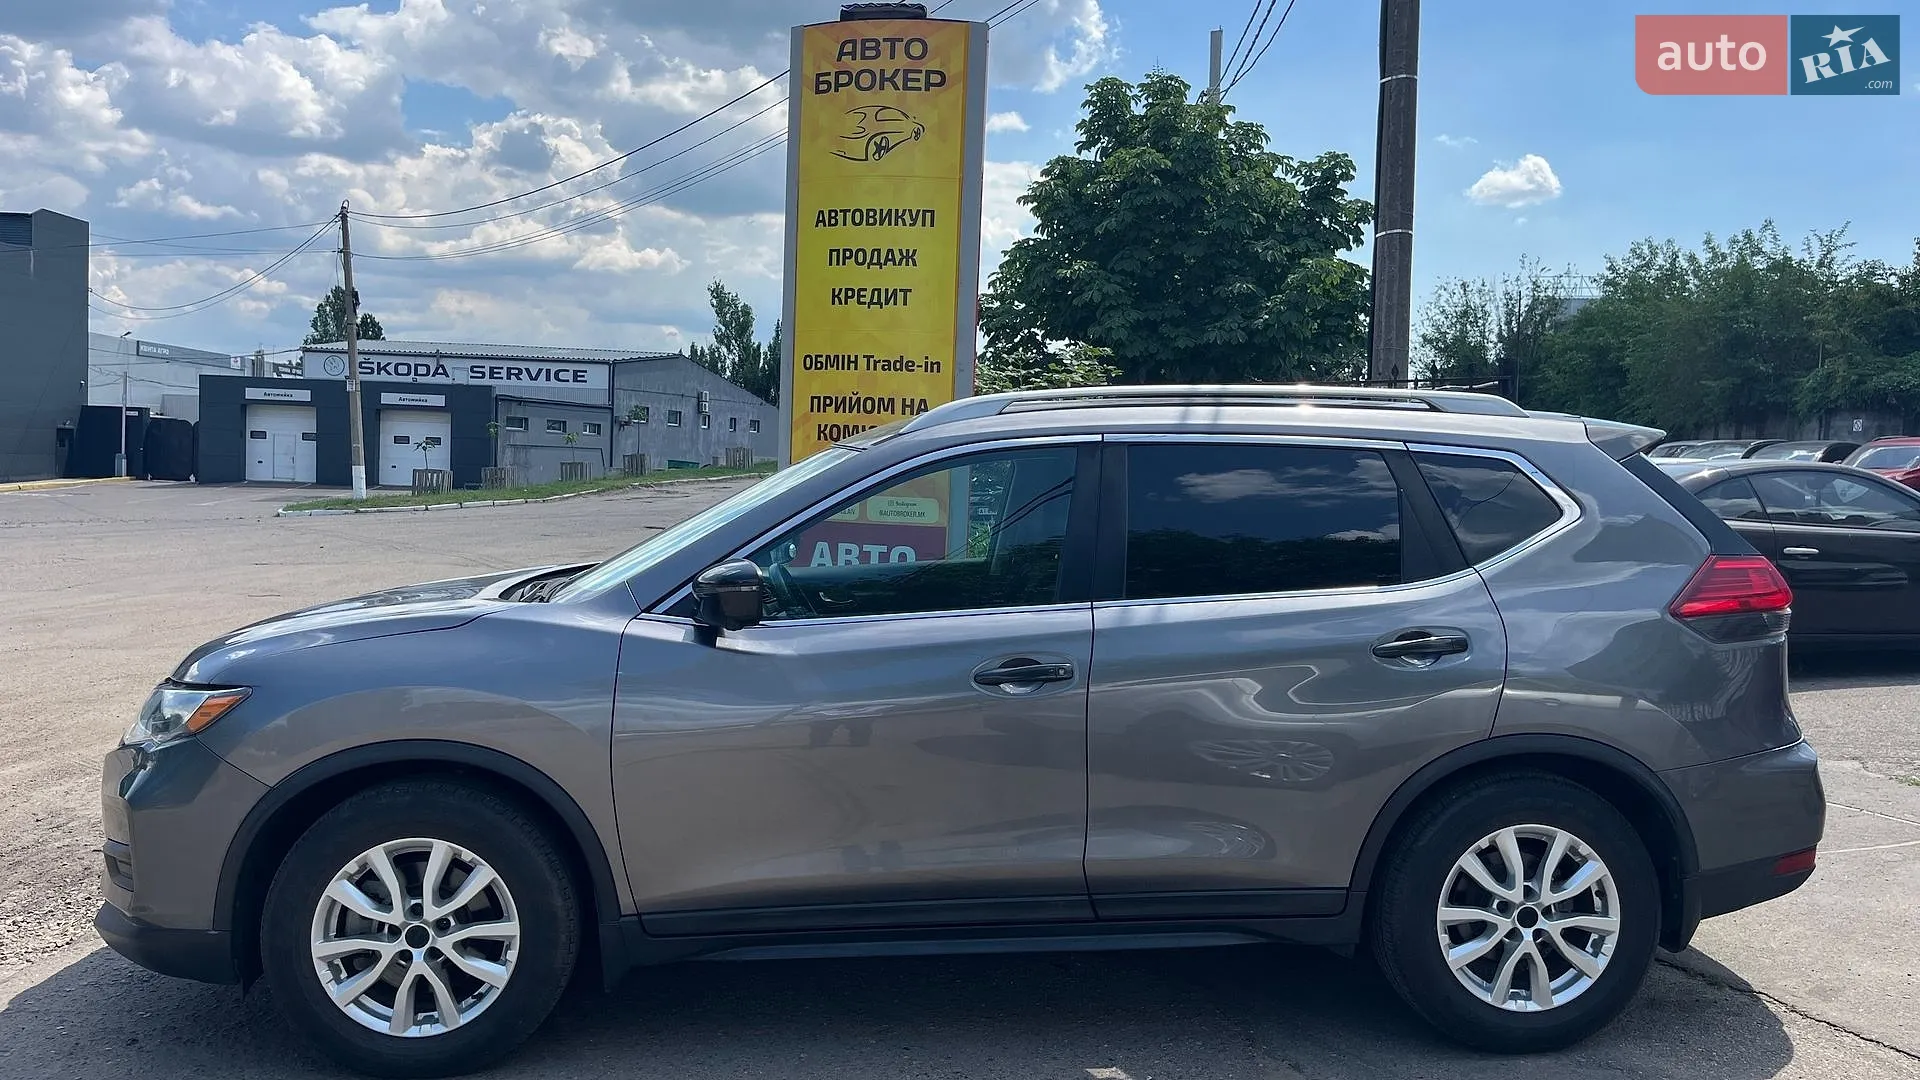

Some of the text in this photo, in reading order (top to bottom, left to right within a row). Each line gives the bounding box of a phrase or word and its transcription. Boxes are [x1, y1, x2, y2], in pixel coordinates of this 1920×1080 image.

[837, 37, 928, 62] АВТО
[814, 68, 947, 95] БРОКЕР
[814, 208, 936, 228] АВТОВИКУП
[828, 248, 918, 270] ПРОДАЖ
[831, 287, 913, 309] КРЕДИТ
[358, 357, 588, 384] ŠKODA SERVICE
[802, 354, 942, 373] ОБМІН Trade-in
[809, 391, 930, 416] ПРИЙОМ НА
[810, 541, 917, 568] АВТО
